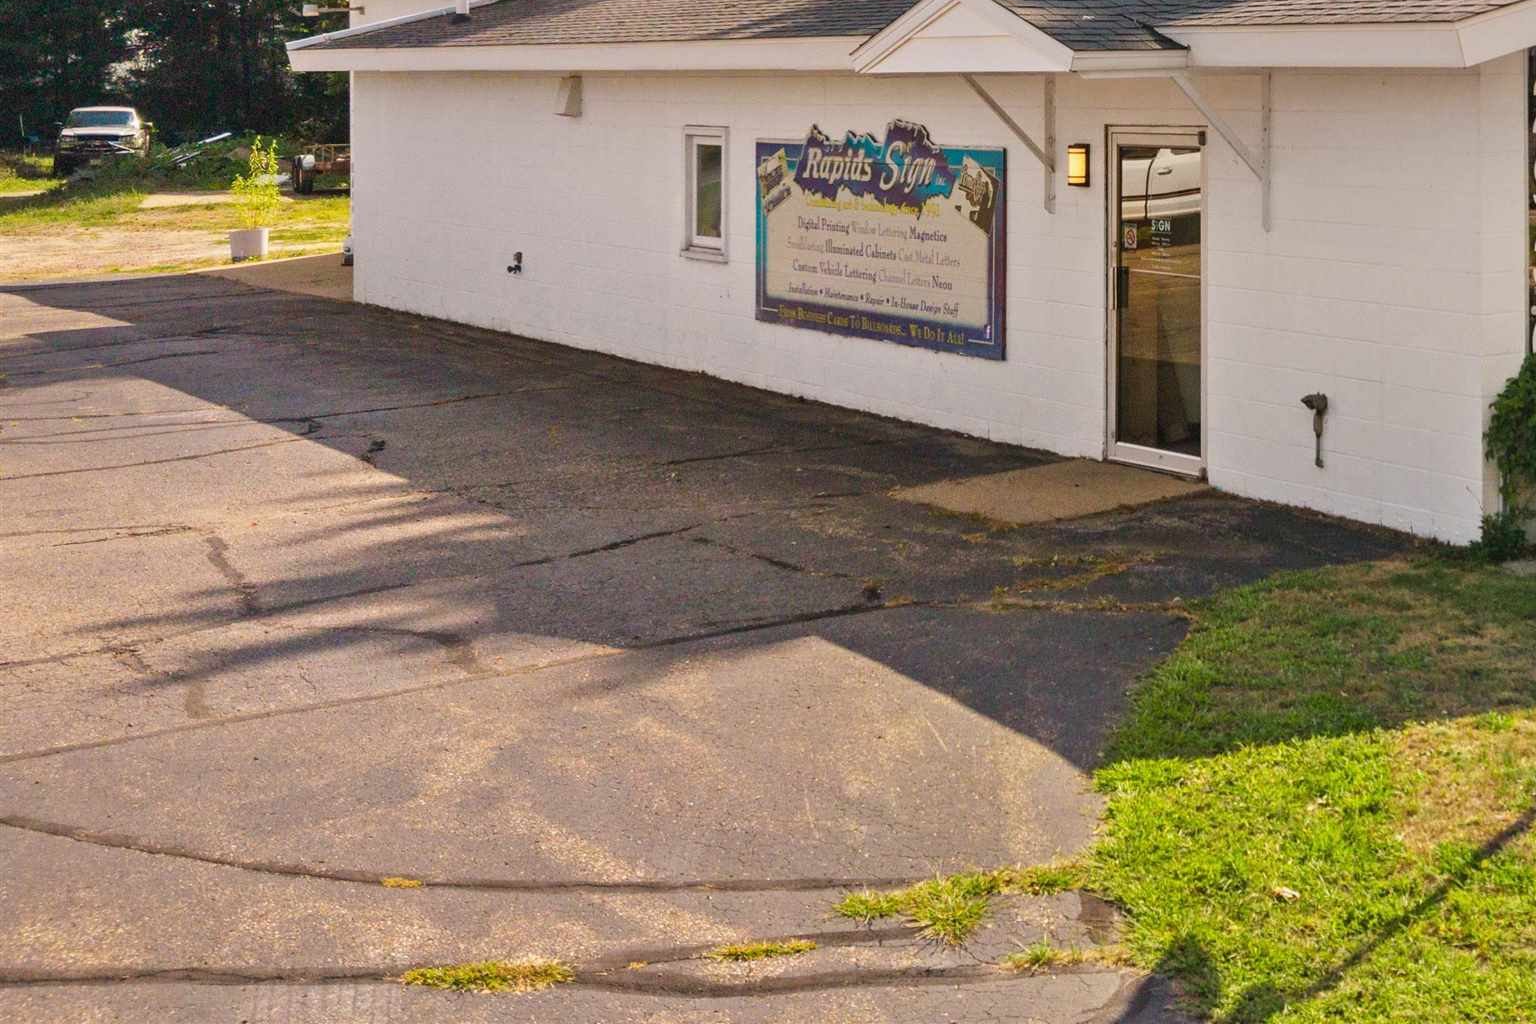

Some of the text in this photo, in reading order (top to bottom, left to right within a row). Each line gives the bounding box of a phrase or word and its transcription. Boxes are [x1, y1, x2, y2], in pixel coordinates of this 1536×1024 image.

[803, 147, 872, 185] Rapids
[880, 141, 937, 193] Sign
[820, 217, 850, 236] Printing
[909, 225, 948, 243] Magnetics
[931, 275, 953, 291] Neon
